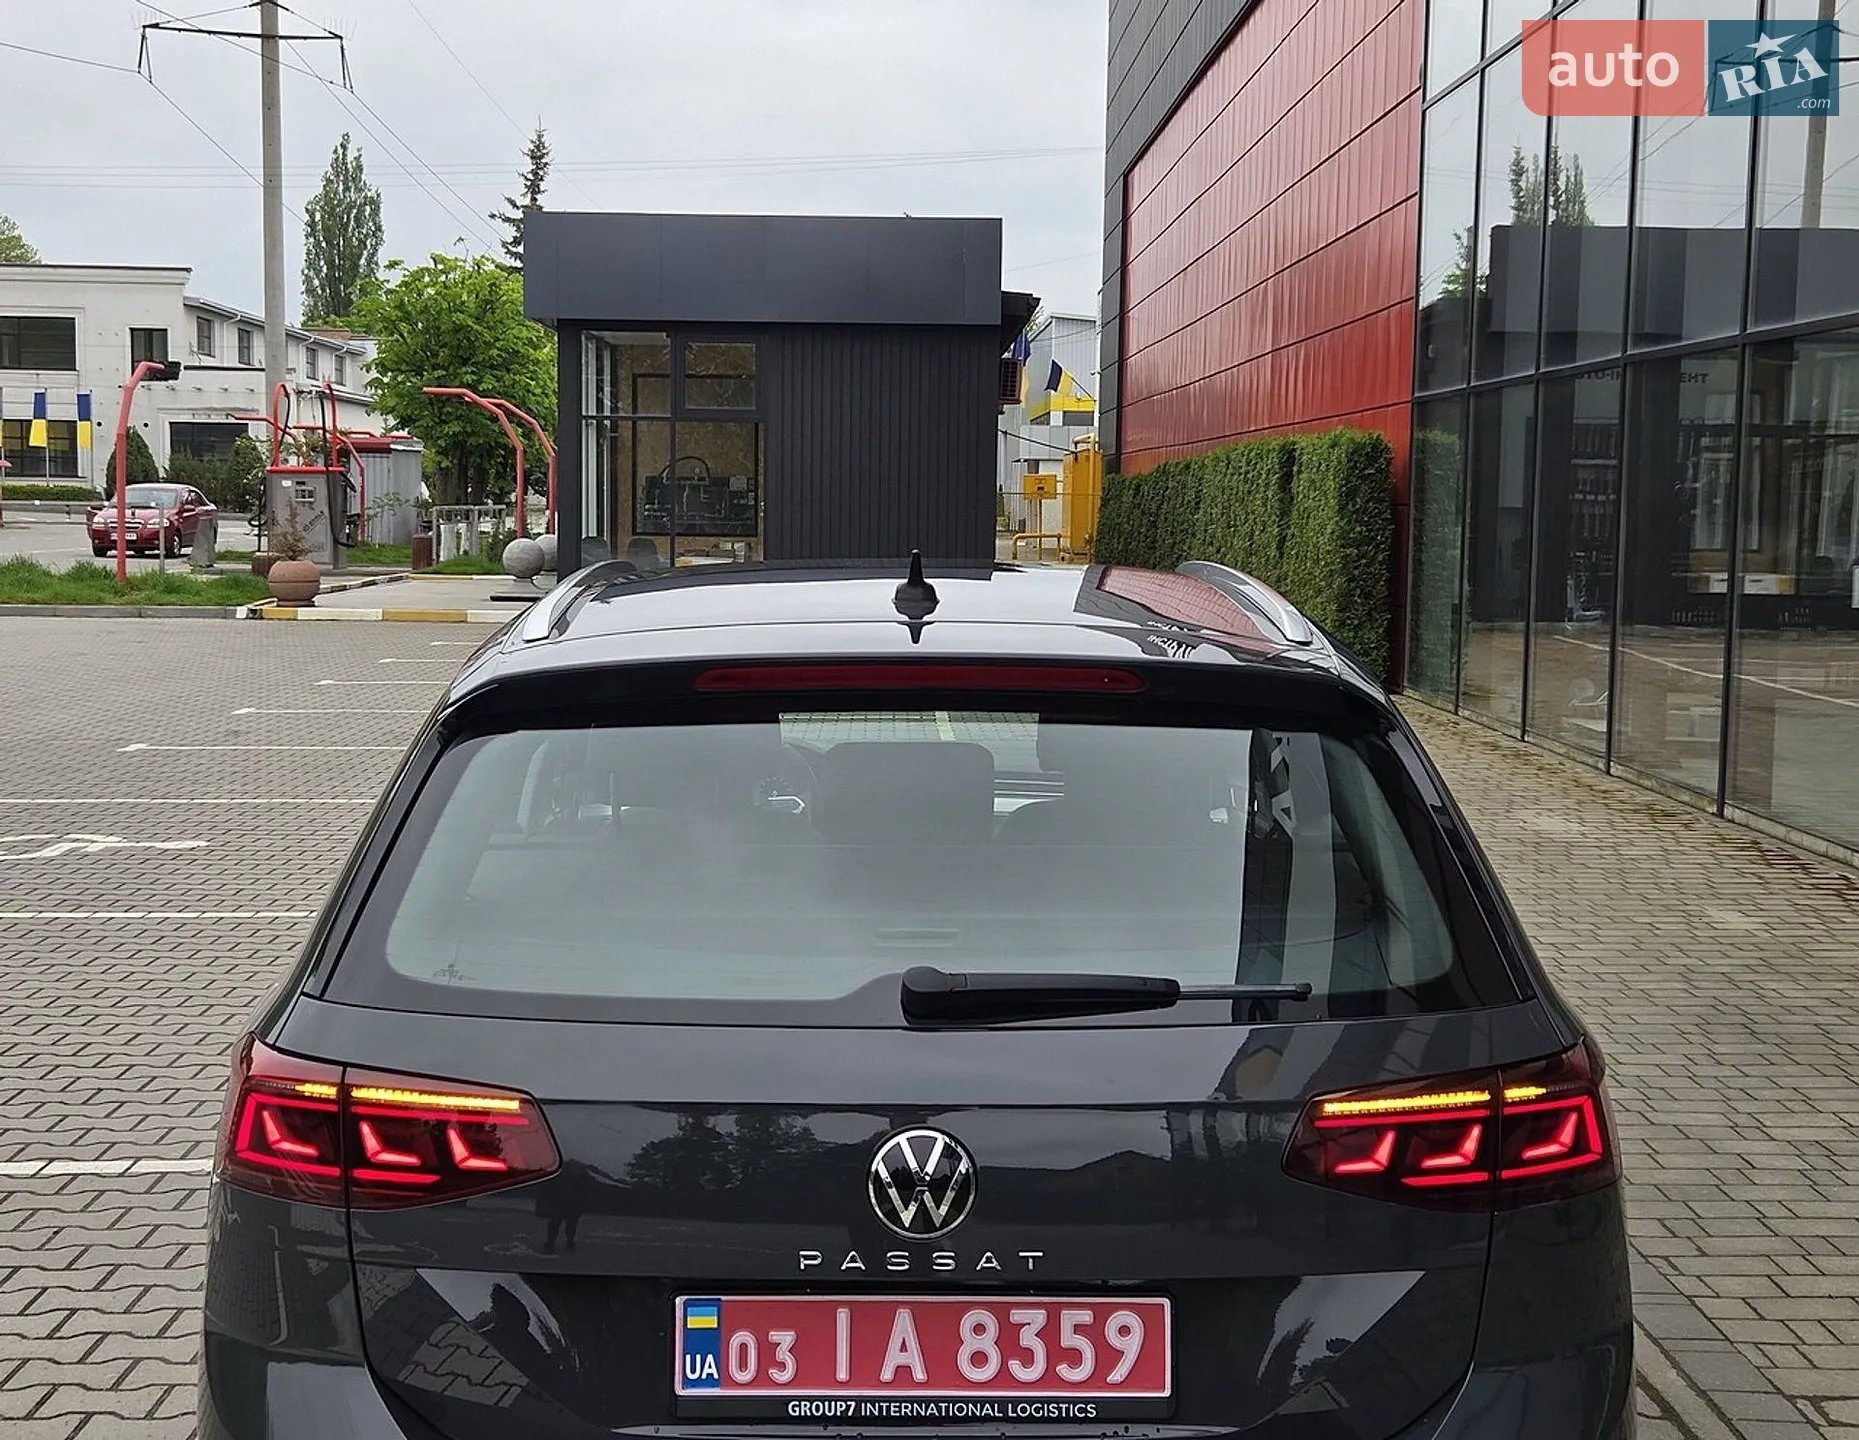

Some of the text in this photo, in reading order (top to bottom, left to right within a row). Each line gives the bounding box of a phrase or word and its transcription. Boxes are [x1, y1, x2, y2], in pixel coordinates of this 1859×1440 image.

[798, 1250, 1045, 1271] PASSAT
[727, 1330, 798, 1385] 03
[956, 1308, 1145, 1385] 8359
[685, 1353, 719, 1380] UA
[787, 1401, 1097, 1418] GROUP7 INTERNATIONAL LOGISTICS
